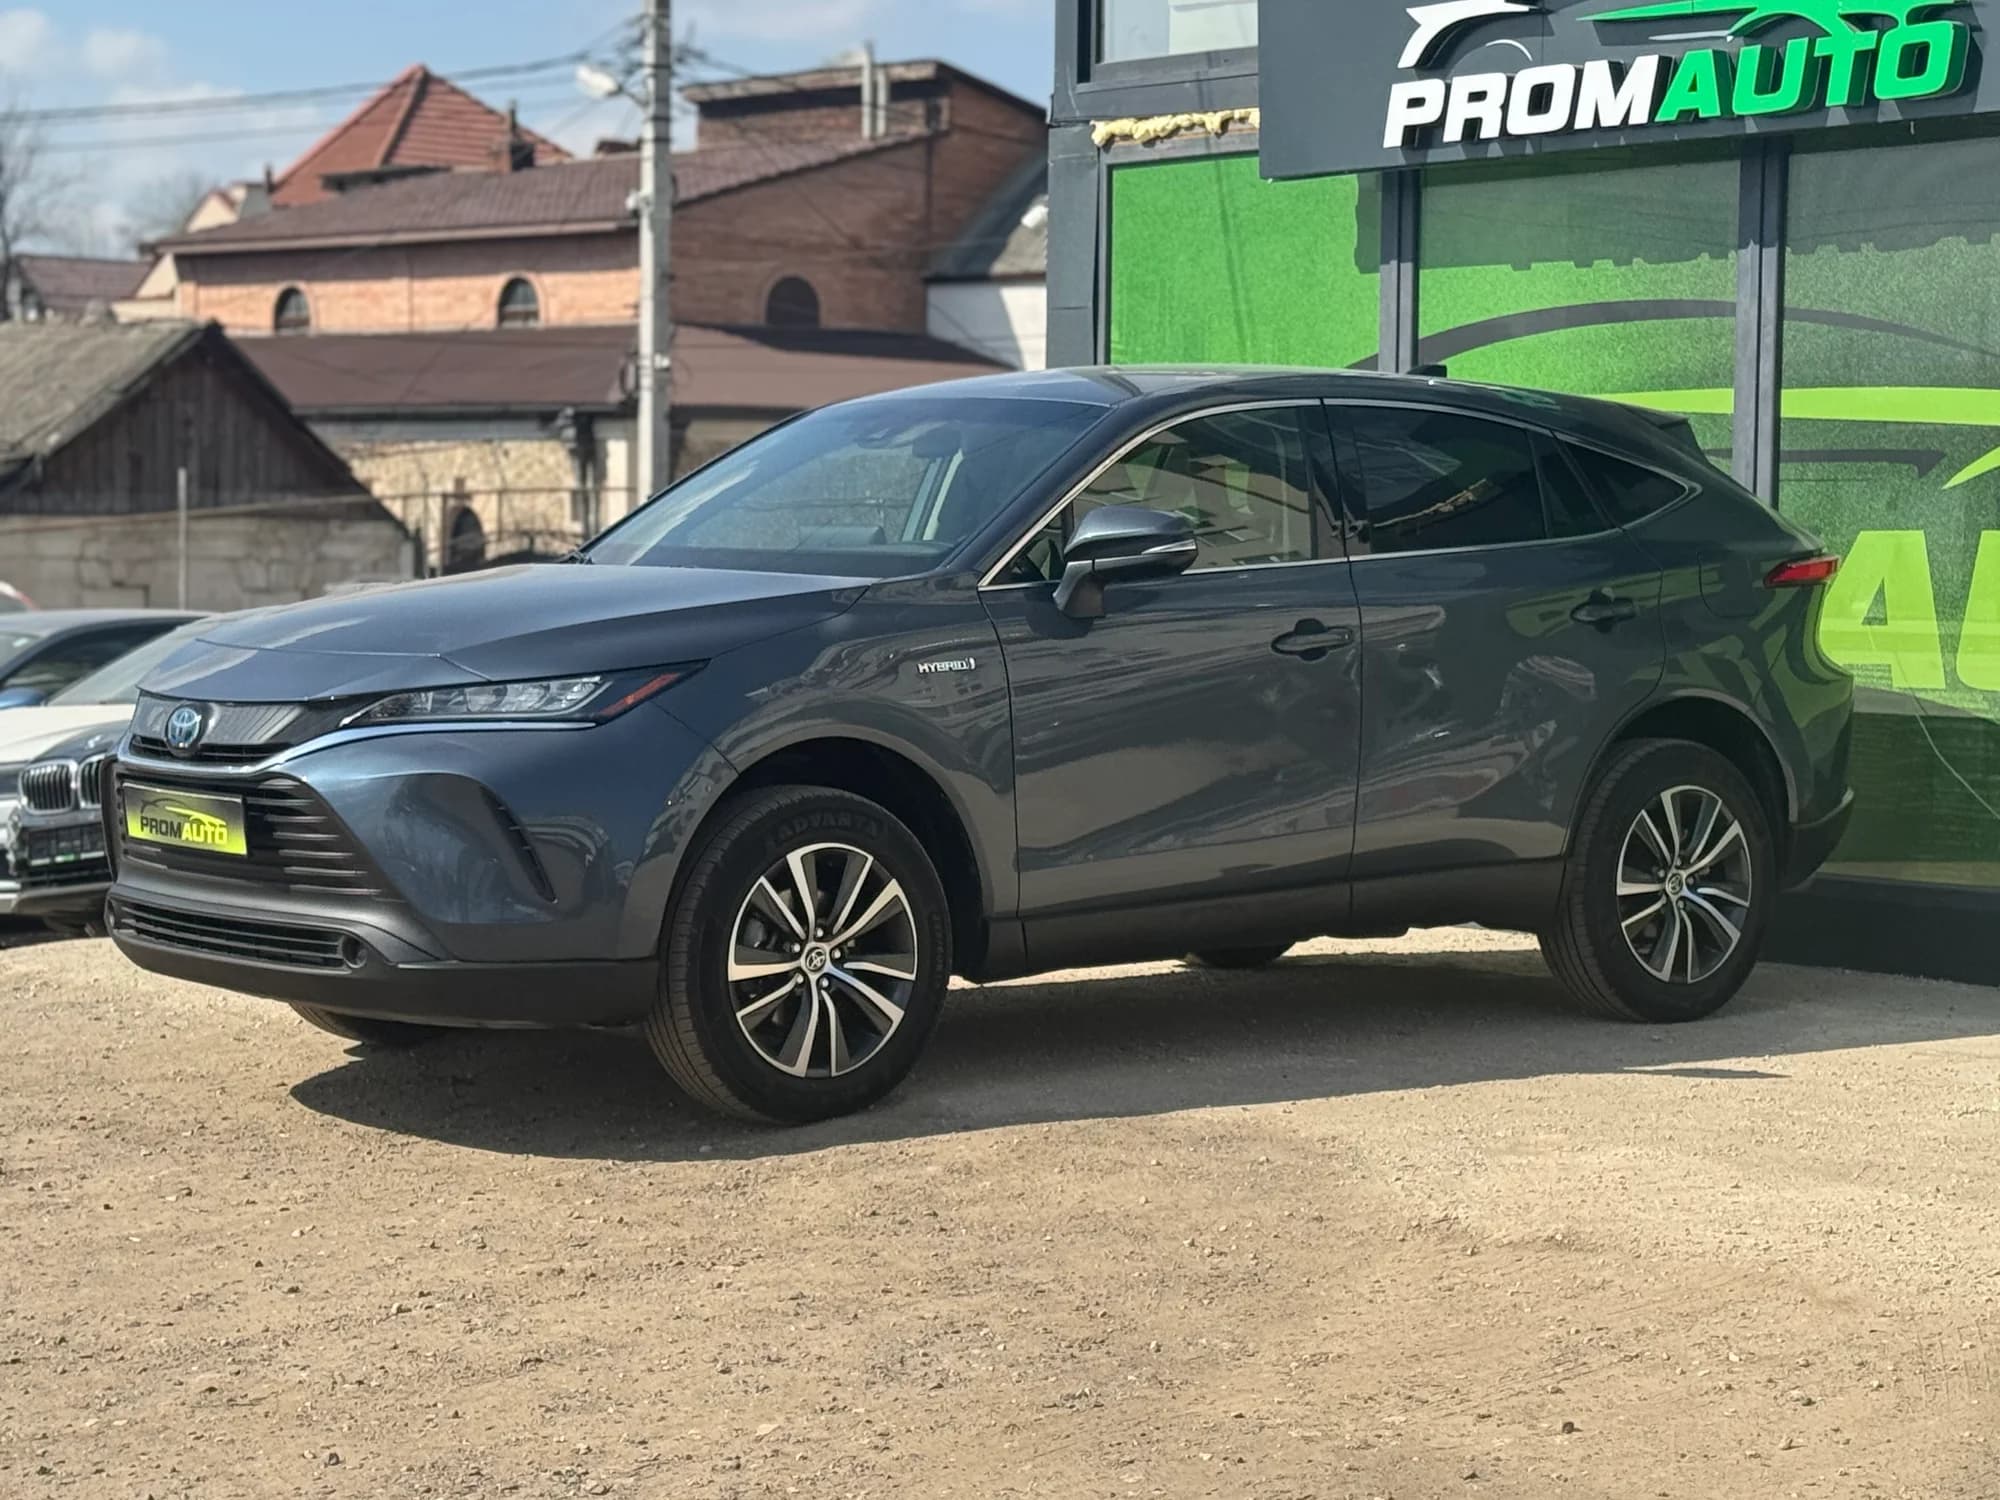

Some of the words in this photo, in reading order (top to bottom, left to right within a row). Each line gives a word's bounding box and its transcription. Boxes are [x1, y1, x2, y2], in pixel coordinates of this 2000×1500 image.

[1382, 20, 1966, 149] PROMAUTO
[917, 660, 970, 673] HYBRID
[140, 815, 228, 845] PROMAUTO
